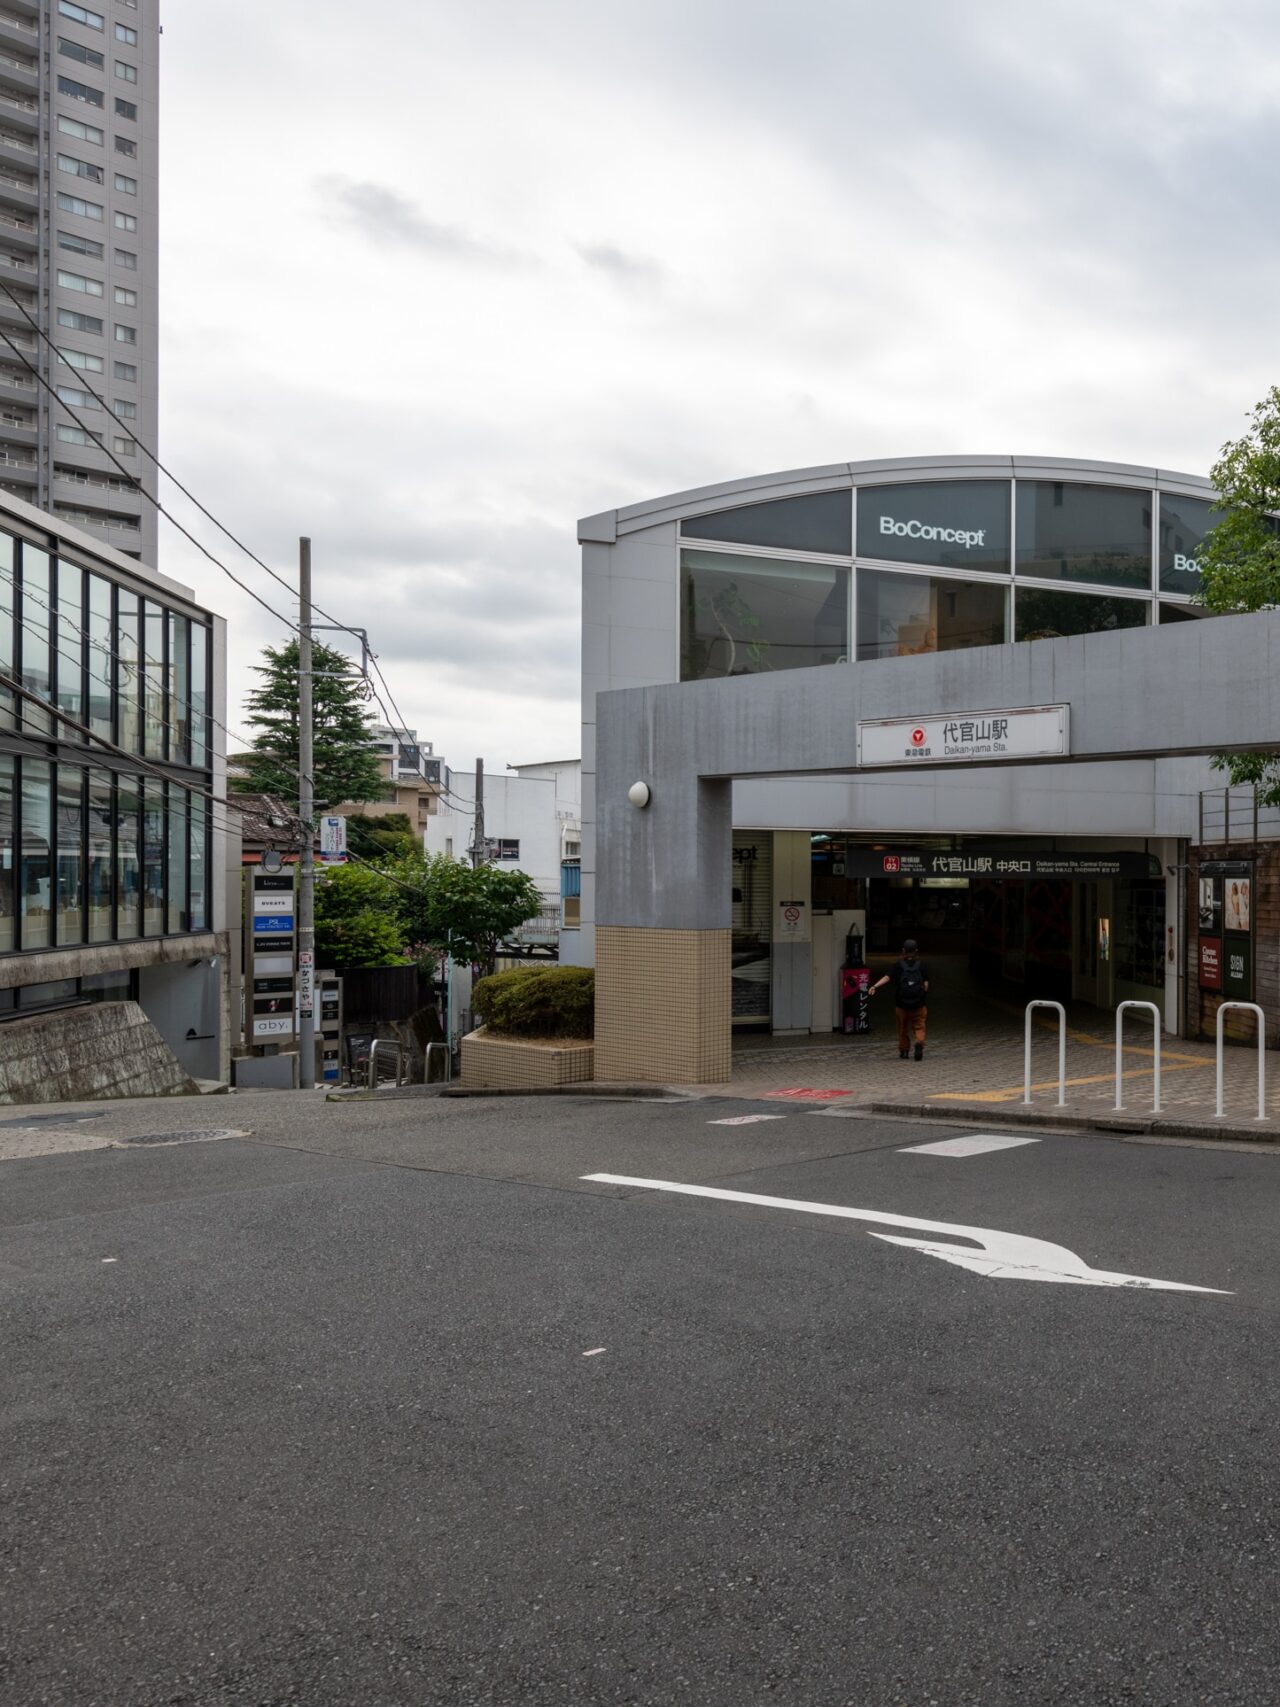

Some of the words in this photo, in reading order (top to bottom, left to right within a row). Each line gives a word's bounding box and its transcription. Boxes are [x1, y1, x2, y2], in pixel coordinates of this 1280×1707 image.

[880, 516, 985, 549] BoConcept
[942, 719, 1009, 743] 代官山駅
[944, 744, 991, 756] Daikan-yama
[992, 742, 1009, 752] Sta.
[886, 862, 897, 870] 02
[932, 856, 993, 872] 代官山駅
[996, 859, 1031, 872] 中央口
